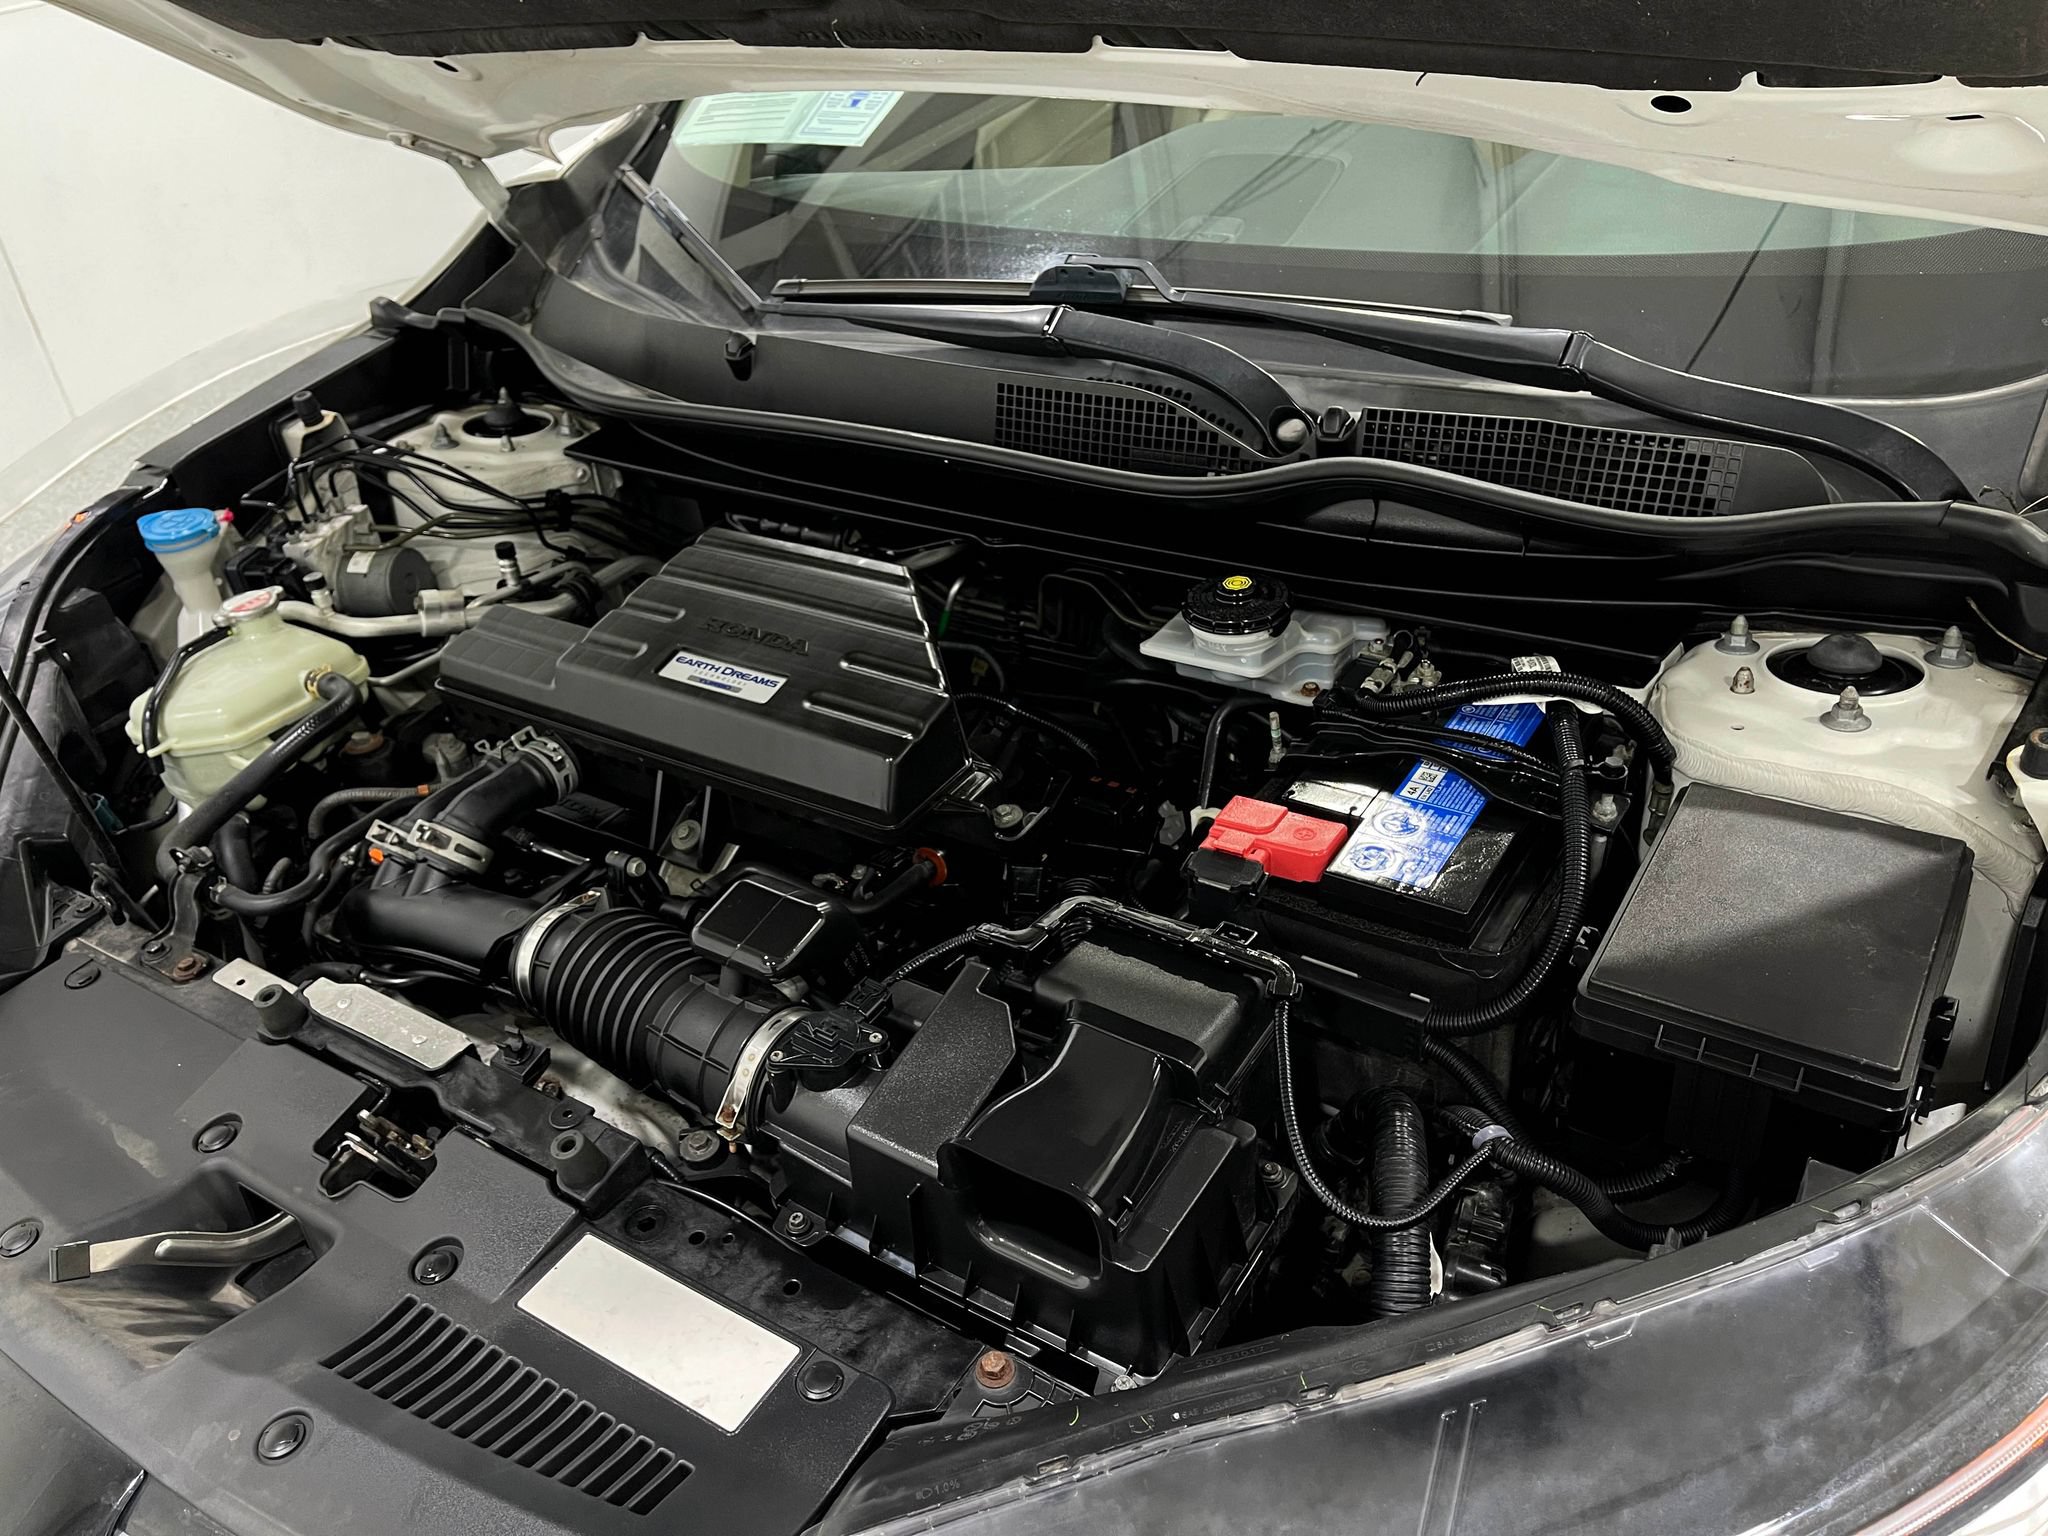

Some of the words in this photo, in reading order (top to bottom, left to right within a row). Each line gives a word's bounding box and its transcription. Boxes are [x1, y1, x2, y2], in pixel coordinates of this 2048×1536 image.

[676, 656, 721, 673] EARTH
[721, 667, 780, 688] DREAMS
[934, 1479, 960, 1495] 1.0%
